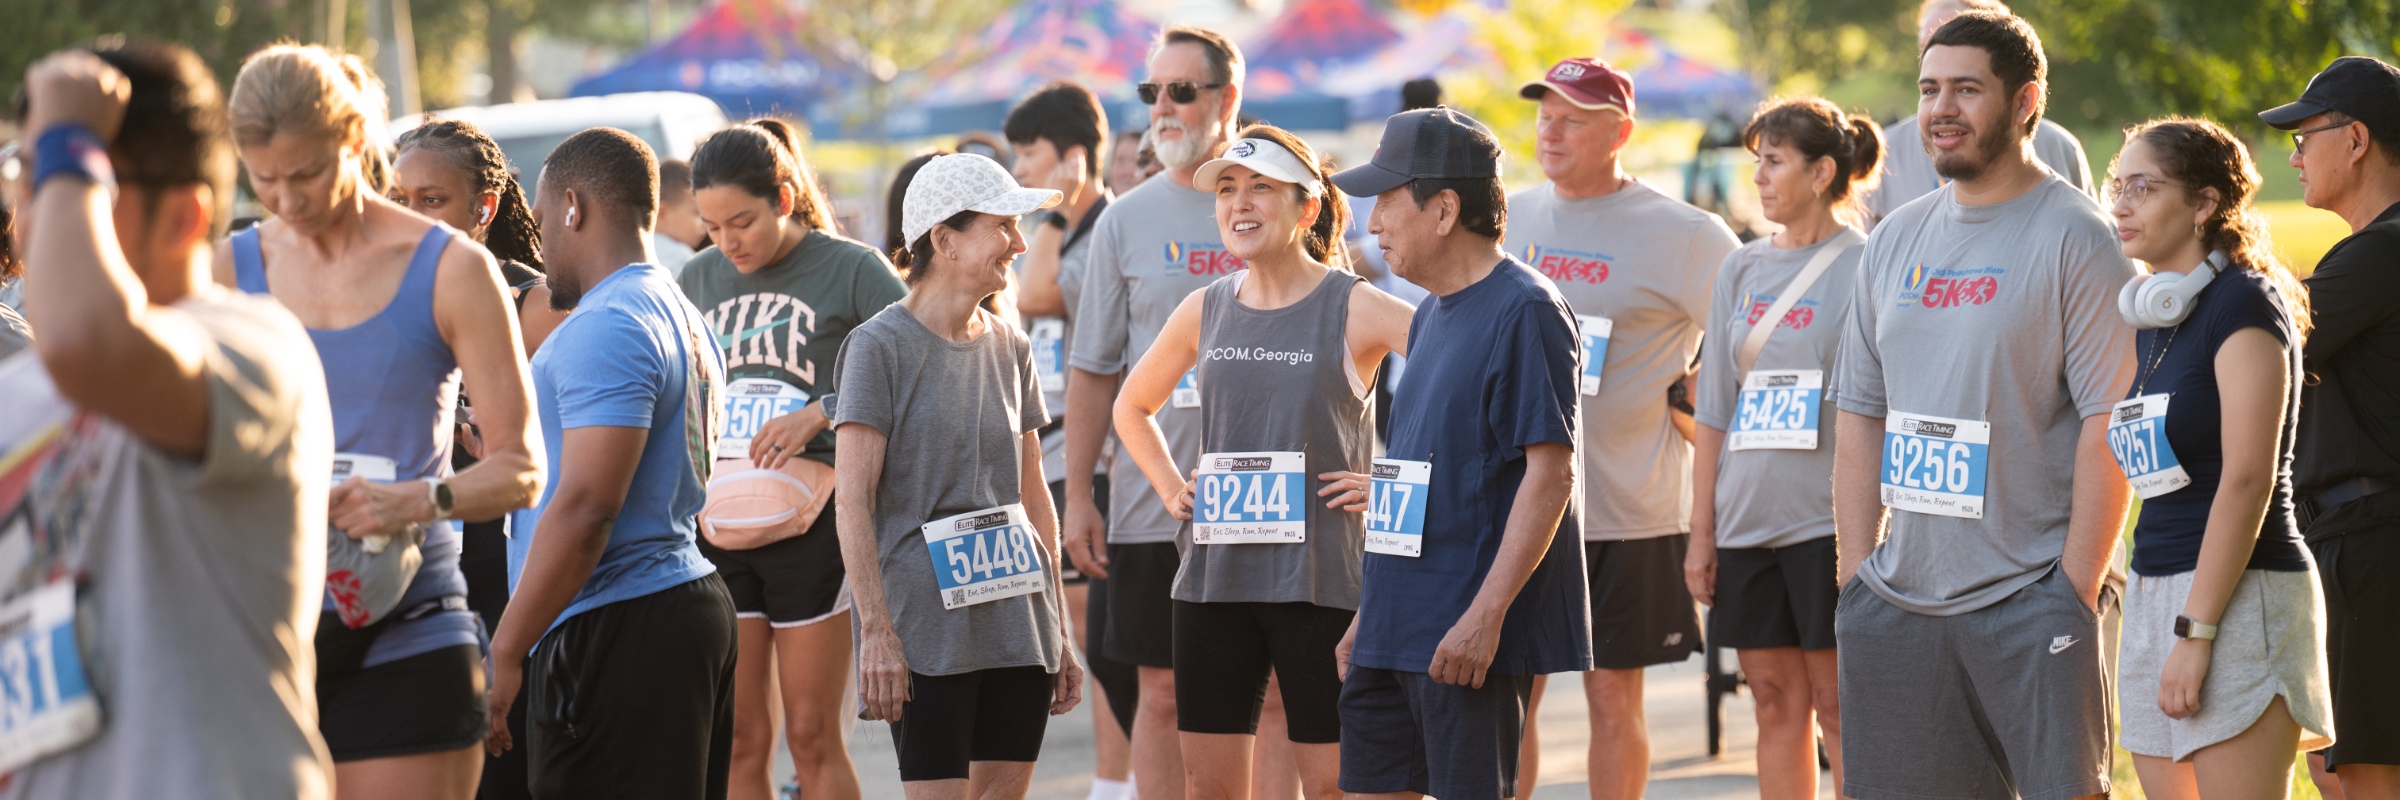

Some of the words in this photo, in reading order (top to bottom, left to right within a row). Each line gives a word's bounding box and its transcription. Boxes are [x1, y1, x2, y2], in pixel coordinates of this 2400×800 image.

[1554, 63, 1586, 77] FSU
[1187, 250, 1227, 276] 5K
[1540, 256, 1577, 282] 5K
[1983, 266, 2005, 275] Blaze
[1922, 277, 1967, 308] 5K
[1740, 389, 1809, 431] 5425
[1890, 434, 1971, 493] 9256
[2110, 418, 2159, 479] 9257
[1203, 474, 1290, 522] 9244
[945, 526, 1031, 585] 5448
[2053, 635, 2072, 647] NIKE
